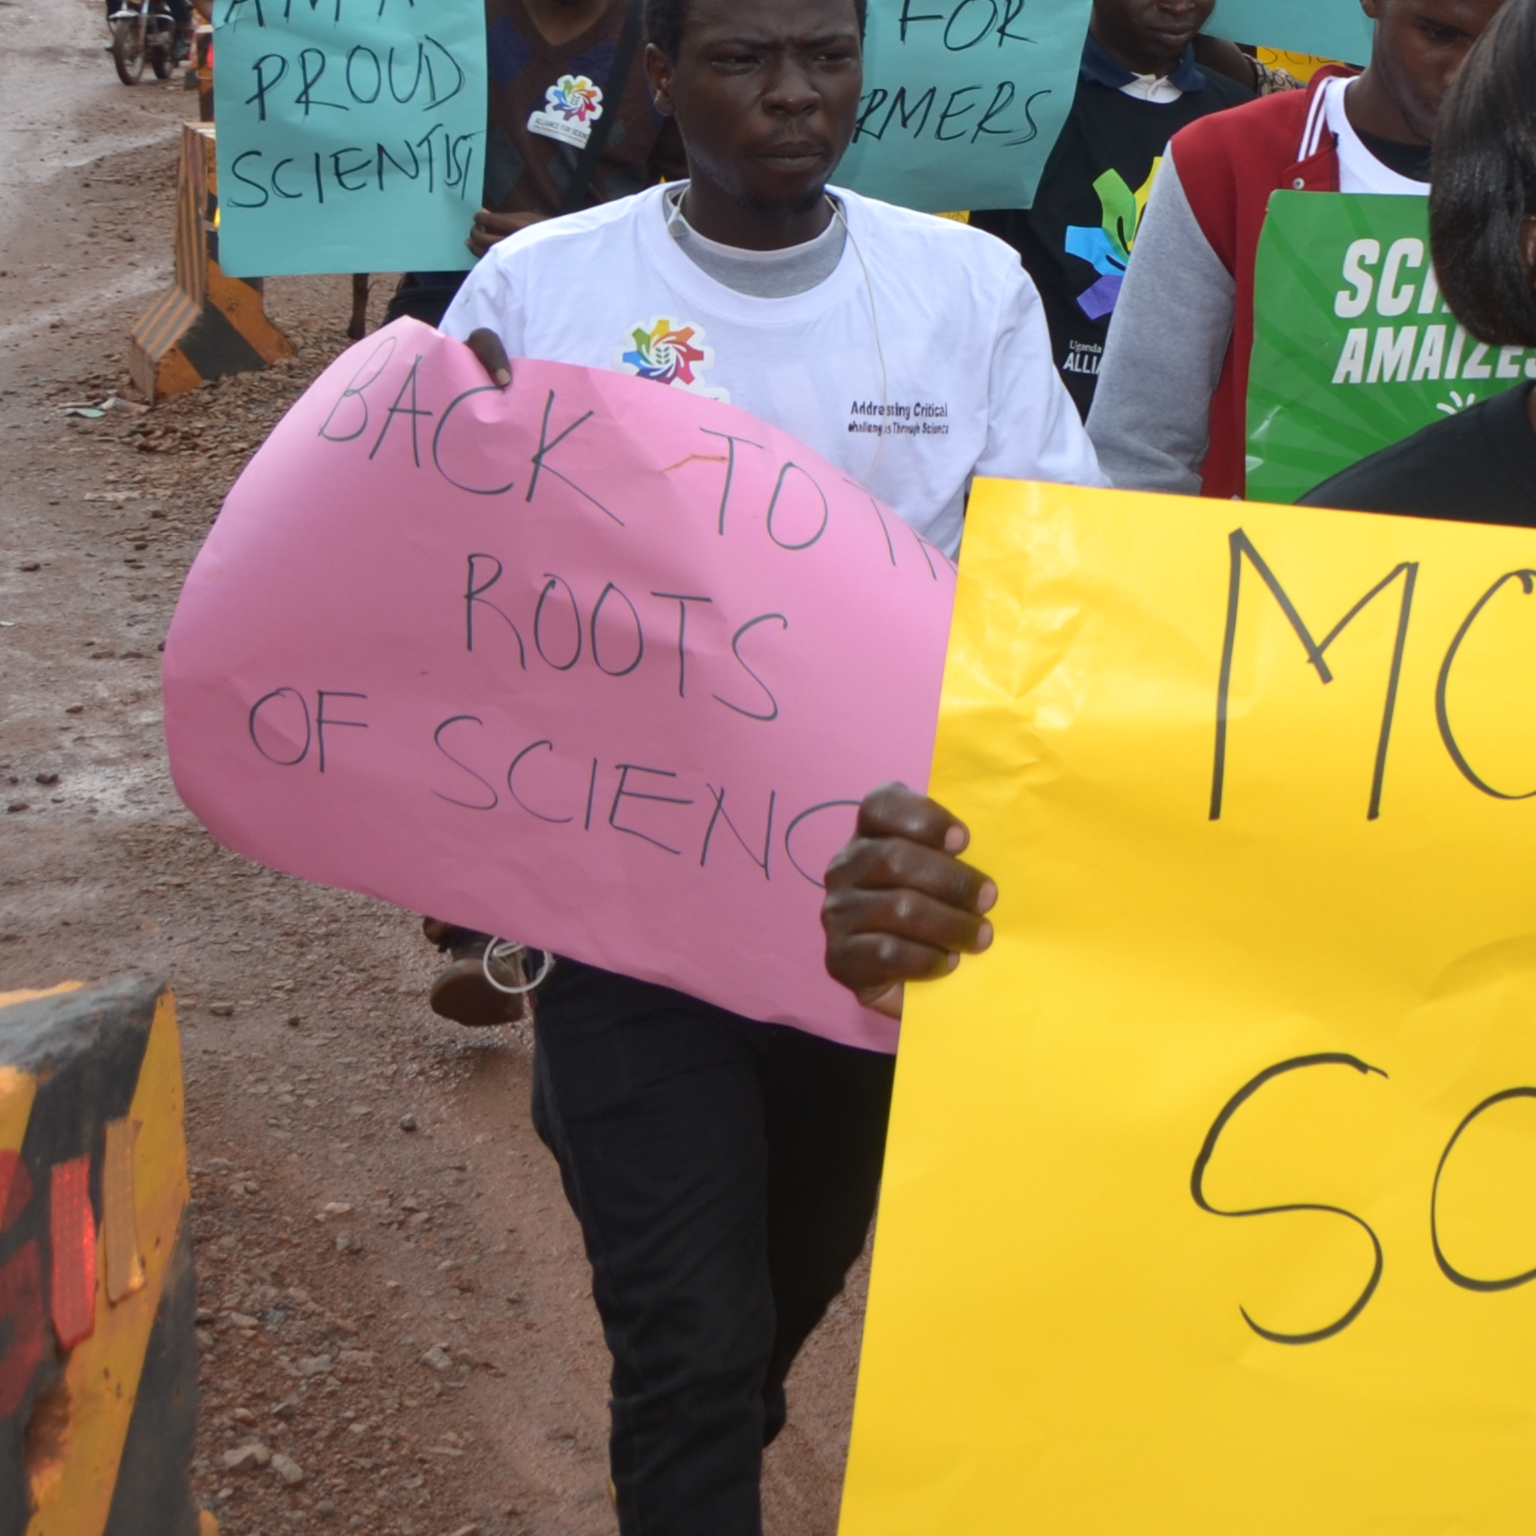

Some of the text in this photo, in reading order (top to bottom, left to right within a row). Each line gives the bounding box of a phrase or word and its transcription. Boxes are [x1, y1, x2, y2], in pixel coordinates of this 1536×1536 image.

[247, 34, 467, 122] PROUD
[851, 80, 1052, 148] RMERS
[1334, 238, 1454, 318] SCI
[319, 336, 625, 527] BACK
[700, 428, 828, 550] TO
[913, 401, 948, 418] Critical
[467, 552, 788, 722] ROOTS
[248, 687, 863, 888] OF SCIENC
